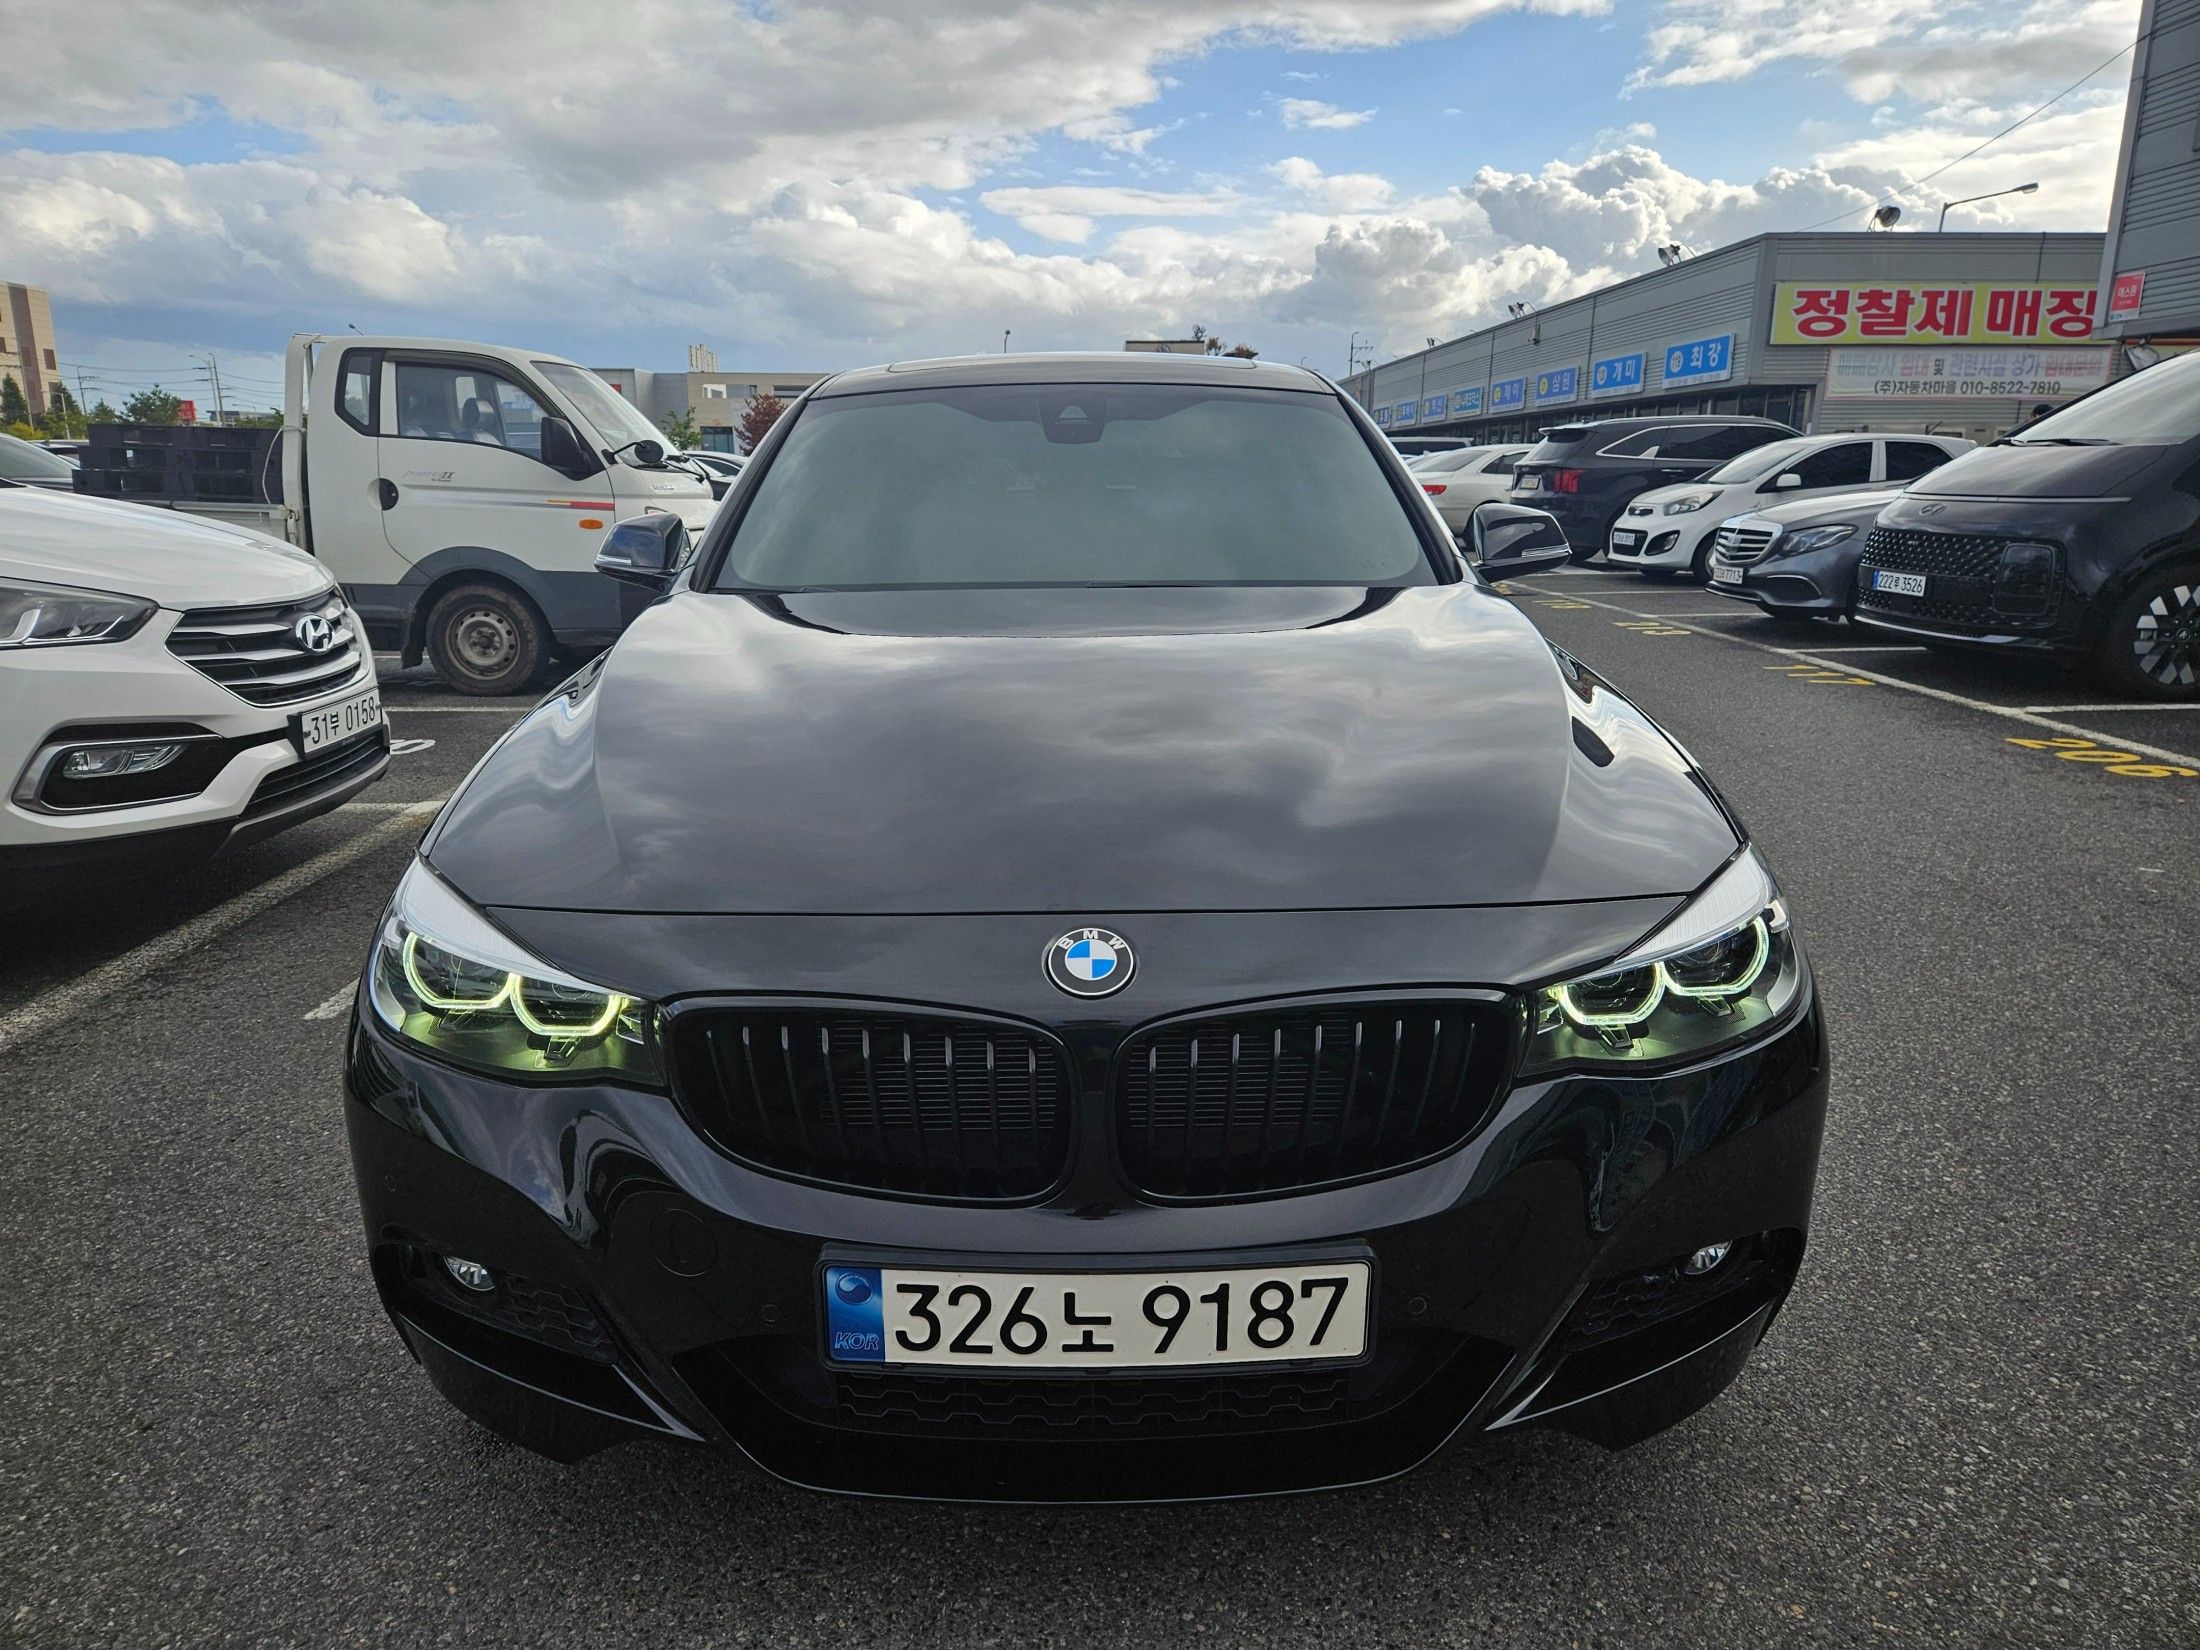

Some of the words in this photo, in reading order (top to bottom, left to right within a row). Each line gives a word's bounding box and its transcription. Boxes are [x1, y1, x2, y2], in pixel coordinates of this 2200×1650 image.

[1793, 289, 1973, 338] 정찰제
[1690, 341, 1721, 369] 최강
[1933, 358, 1944, 376] 및
[2011, 353, 2042, 377] 상가
[1960, 380, 2061, 395] 010-8522-7810
[1901, 576, 1923, 594] 3526
[310, 711, 340, 745] 31부
[345, 696, 376, 732] 0158
[2005, 737, 2199, 778] 206
[1058, 929, 1126, 950] BMW
[894, 1282, 1115, 1355] 326노
[1142, 1277, 1350, 1354] 9187
[834, 1331, 880, 1351] KOR
